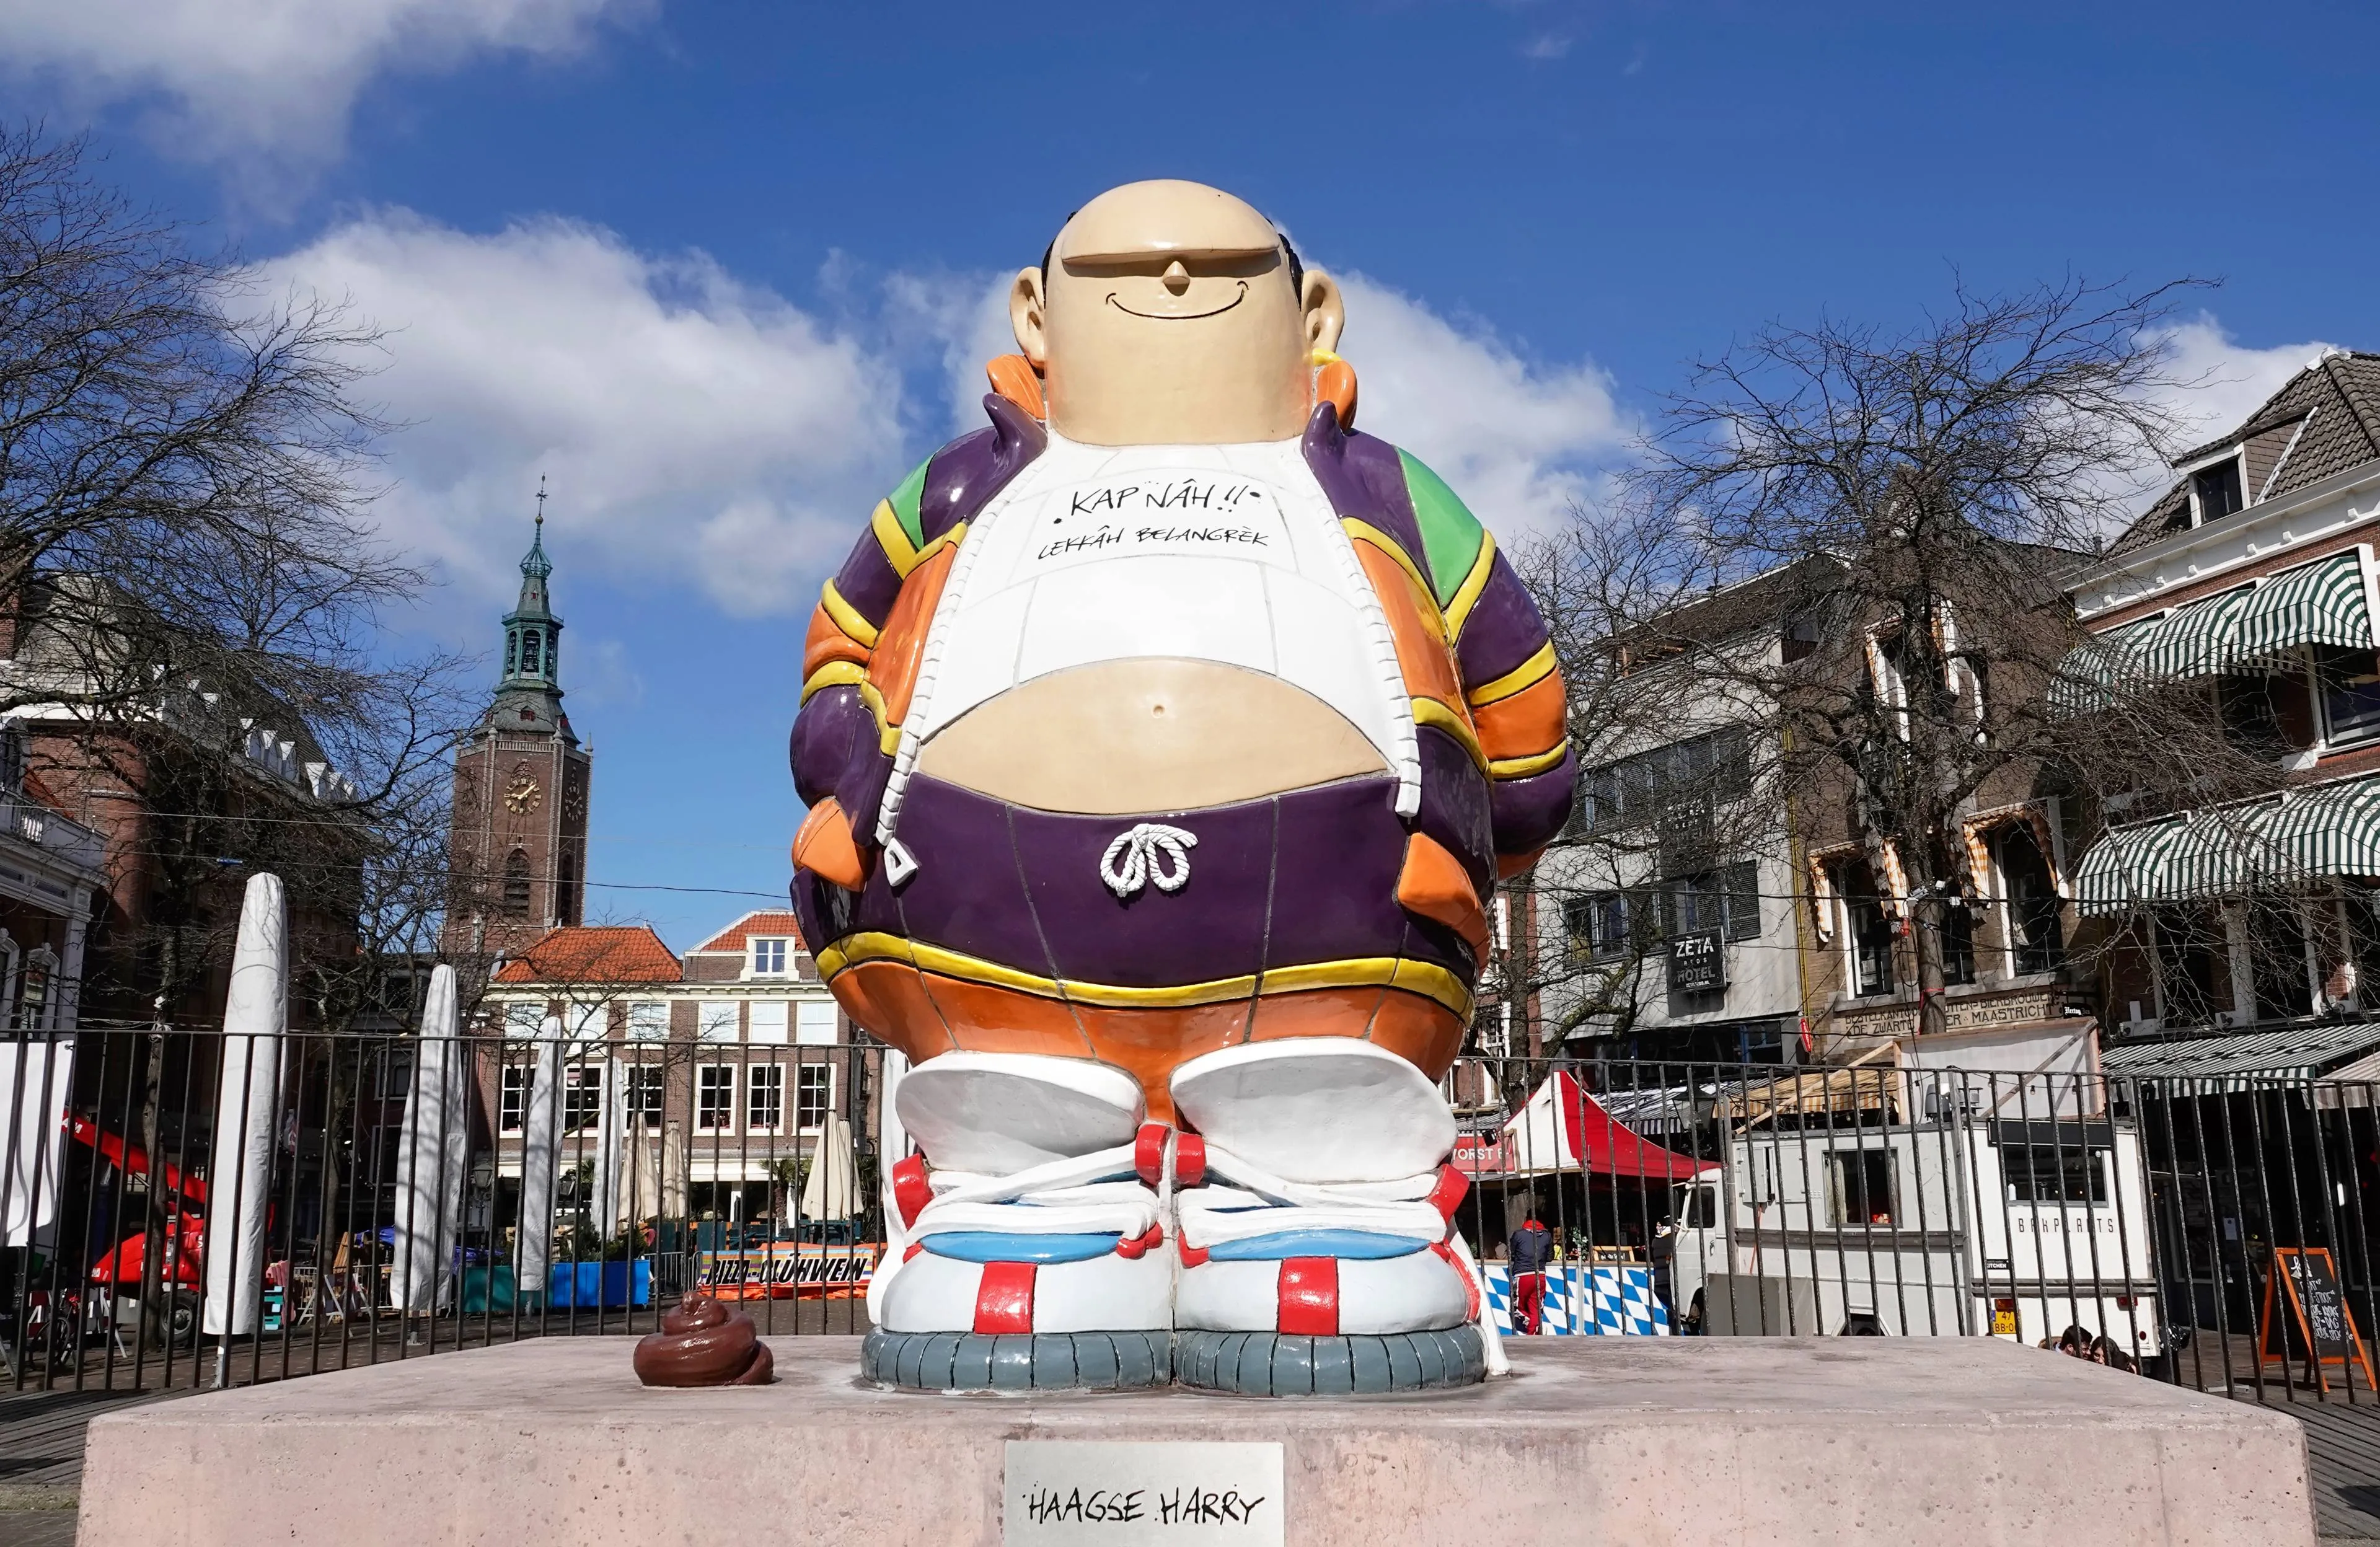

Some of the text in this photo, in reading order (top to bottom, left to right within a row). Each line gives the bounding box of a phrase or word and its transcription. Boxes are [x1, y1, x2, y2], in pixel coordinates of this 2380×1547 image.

[1071, 487, 1139, 516] KAP
[1038, 525, 1268, 560] LEKKÂH BELANGRÈK
[1845, 1005, 1921, 1025] BESTELKANTOO
[1972, 1003, 2053, 1024] MAASTRICHT
[1028, 1486, 1265, 1525] HAAGSE HARRY
